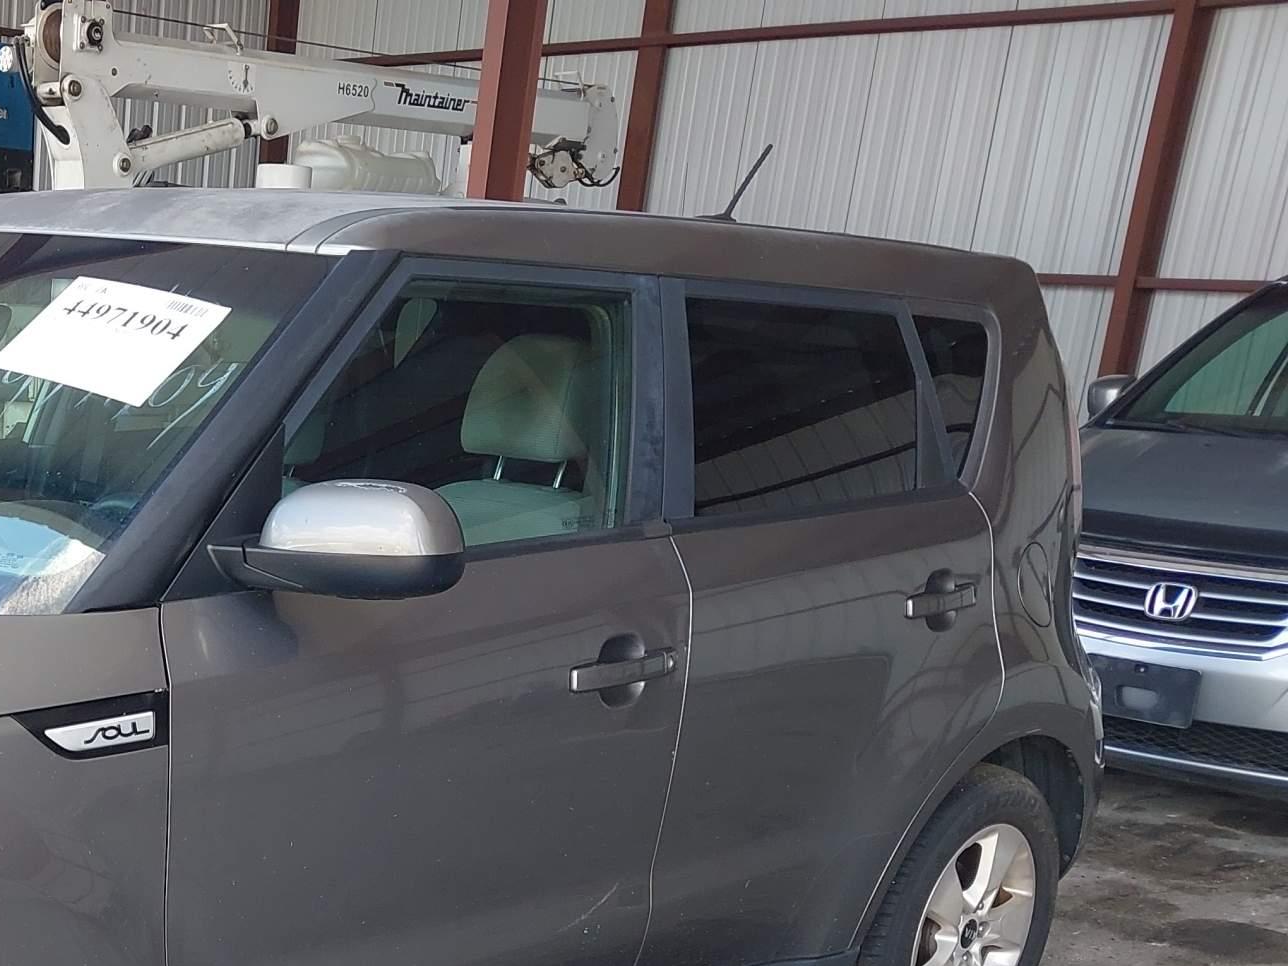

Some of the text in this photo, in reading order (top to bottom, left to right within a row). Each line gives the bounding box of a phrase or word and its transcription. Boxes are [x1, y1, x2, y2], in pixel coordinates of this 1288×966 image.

[337, 82, 470, 112] H6520 Maintainer
[63, 299, 189, 341] 44971904
